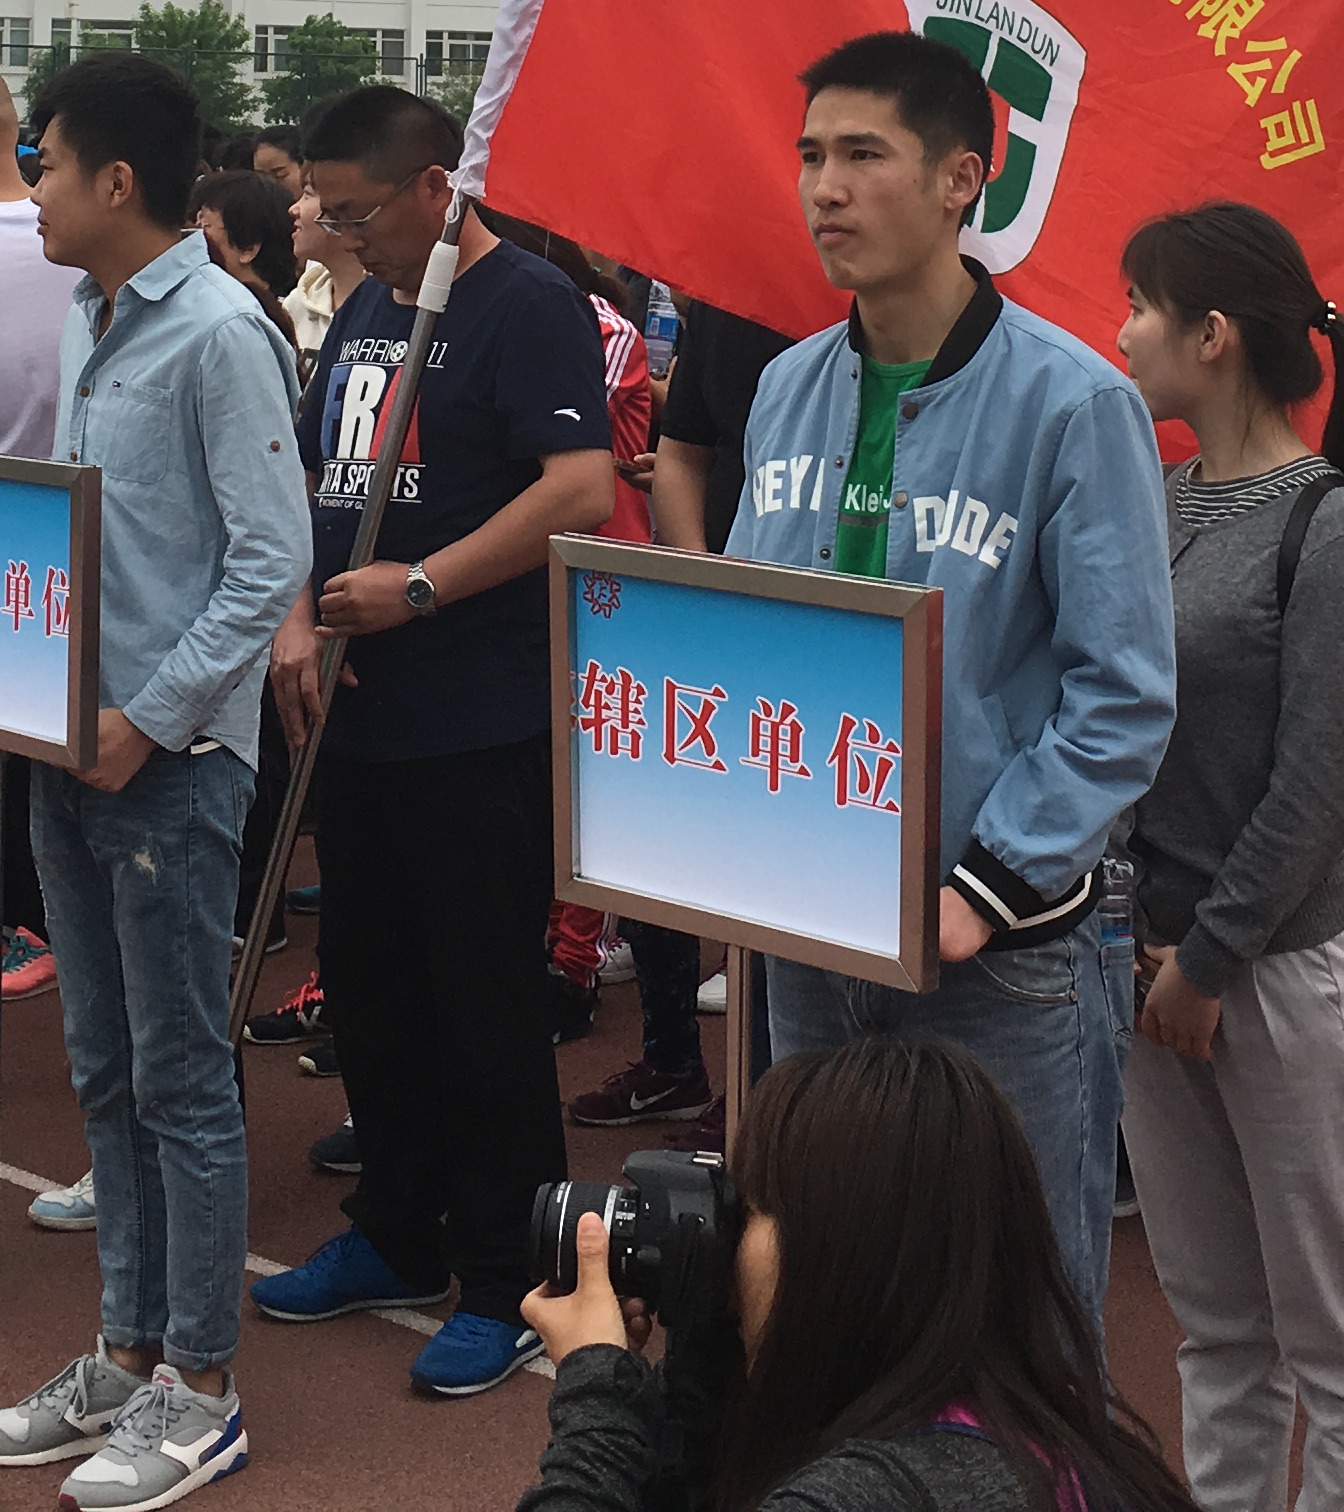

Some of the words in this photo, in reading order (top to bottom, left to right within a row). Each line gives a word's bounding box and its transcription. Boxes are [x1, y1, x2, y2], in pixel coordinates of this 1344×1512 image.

[343, 464, 420, 499] SPTS
[578, 658, 902, 817] 辖区单位
